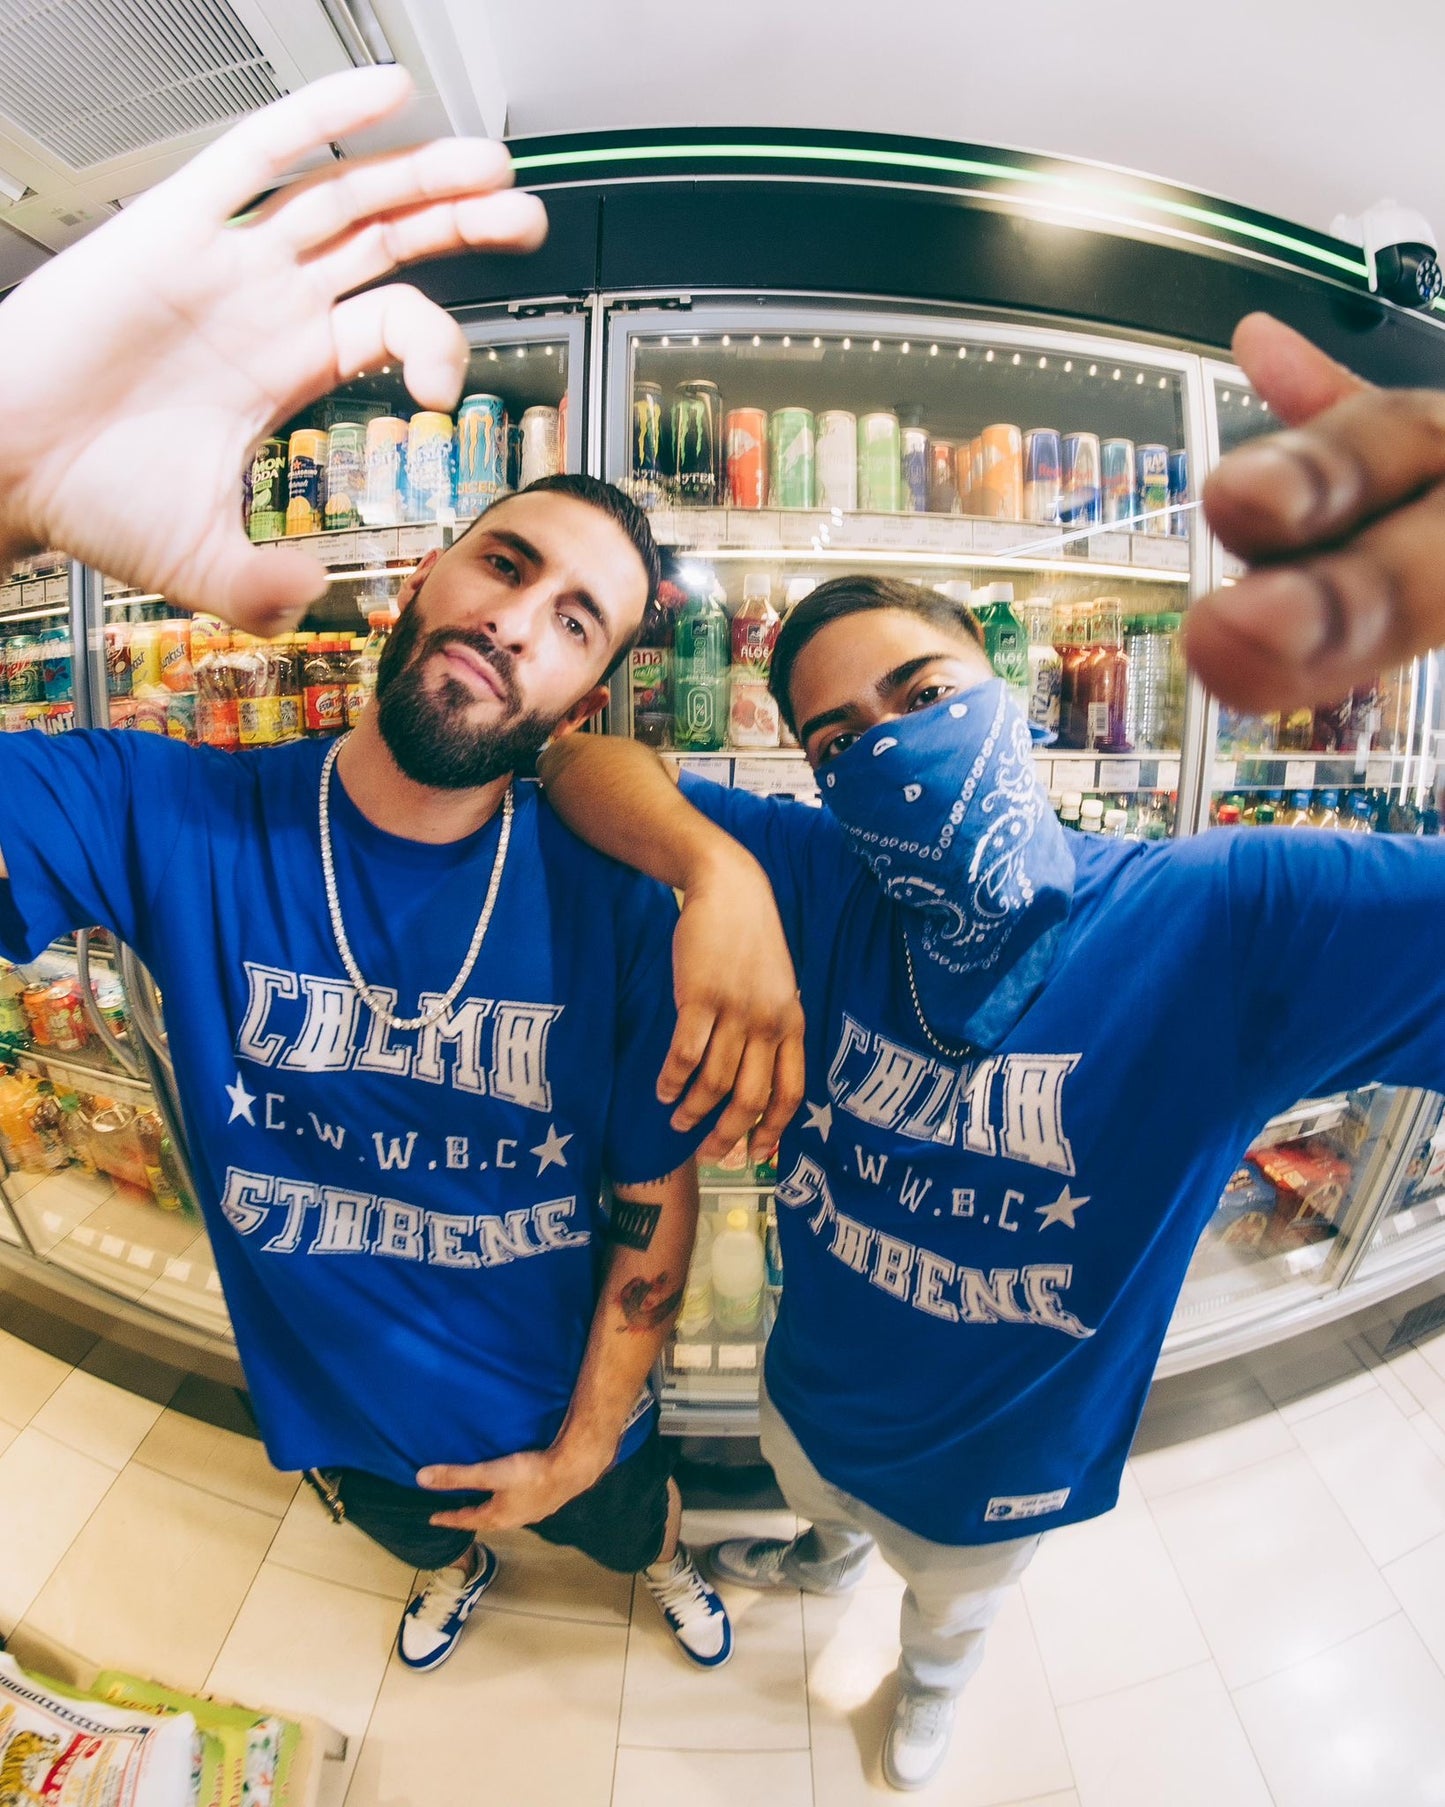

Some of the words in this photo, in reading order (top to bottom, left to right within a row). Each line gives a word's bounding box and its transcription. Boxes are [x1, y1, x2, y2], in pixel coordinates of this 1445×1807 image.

[632, 650, 663, 666] ana
[234, 961, 565, 1113] CALMA
[827, 1011, 1083, 1177] CALMA
[220, 1165, 592, 1269] STABENE
